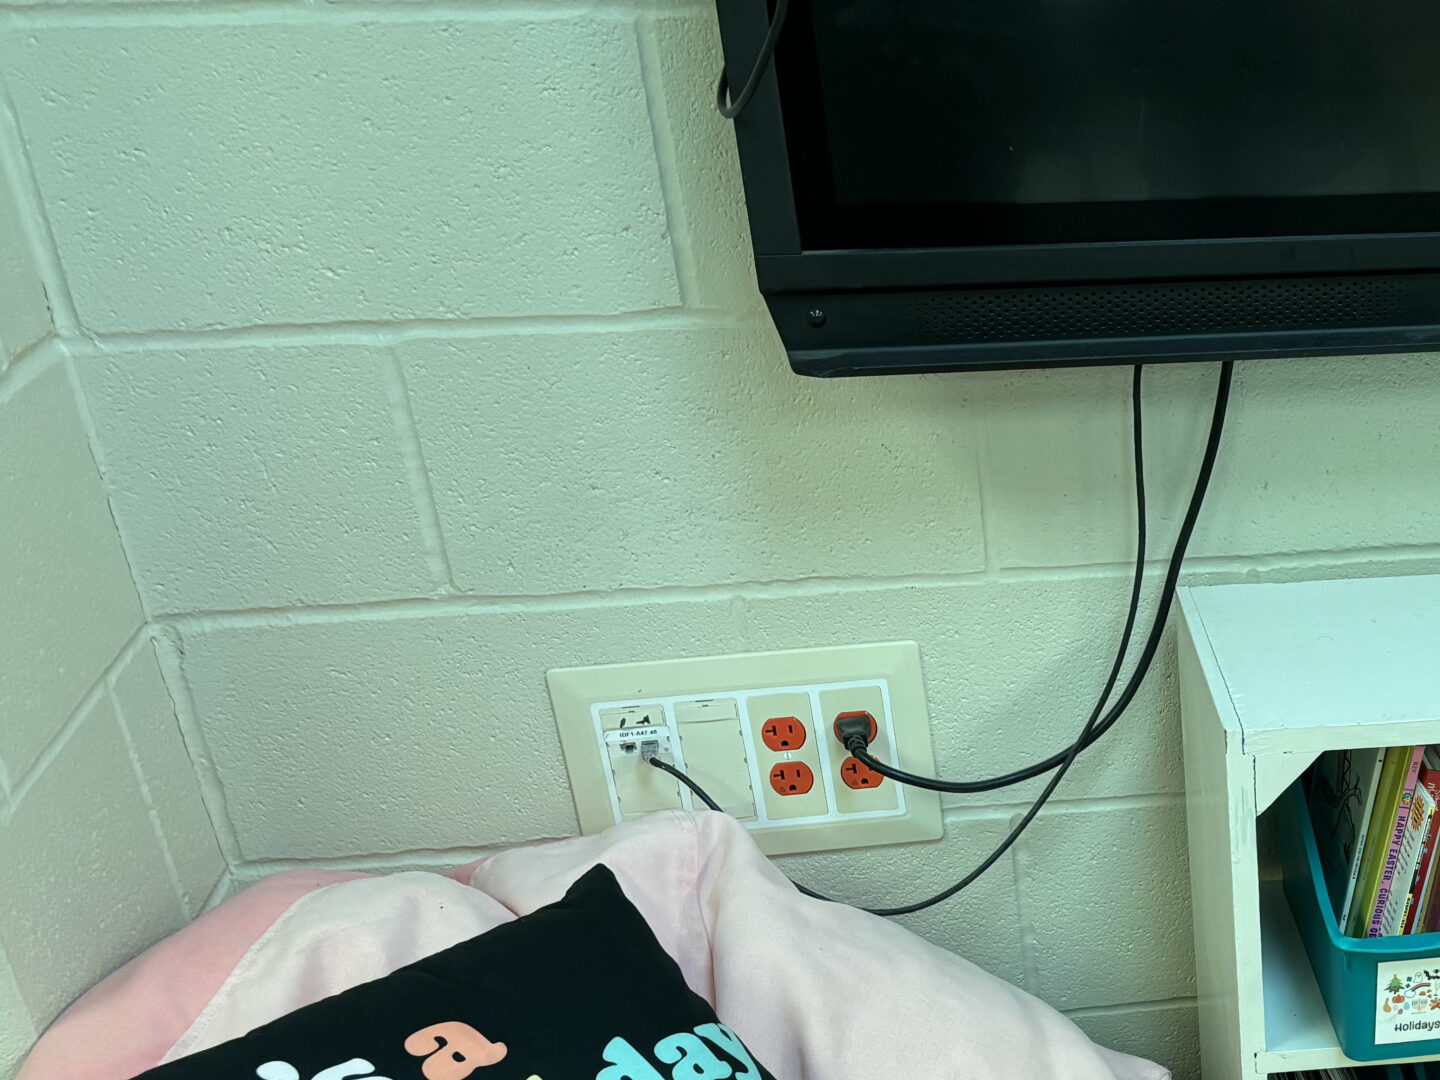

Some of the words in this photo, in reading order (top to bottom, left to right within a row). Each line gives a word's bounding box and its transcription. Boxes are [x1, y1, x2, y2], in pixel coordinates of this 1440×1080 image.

[1390, 816, 1406, 846] HAPPY
[1380, 849, 1399, 885] EASTER,
[1371, 888, 1388, 926] CURIOUS
[1394, 1020, 1440, 1032] Holidays
